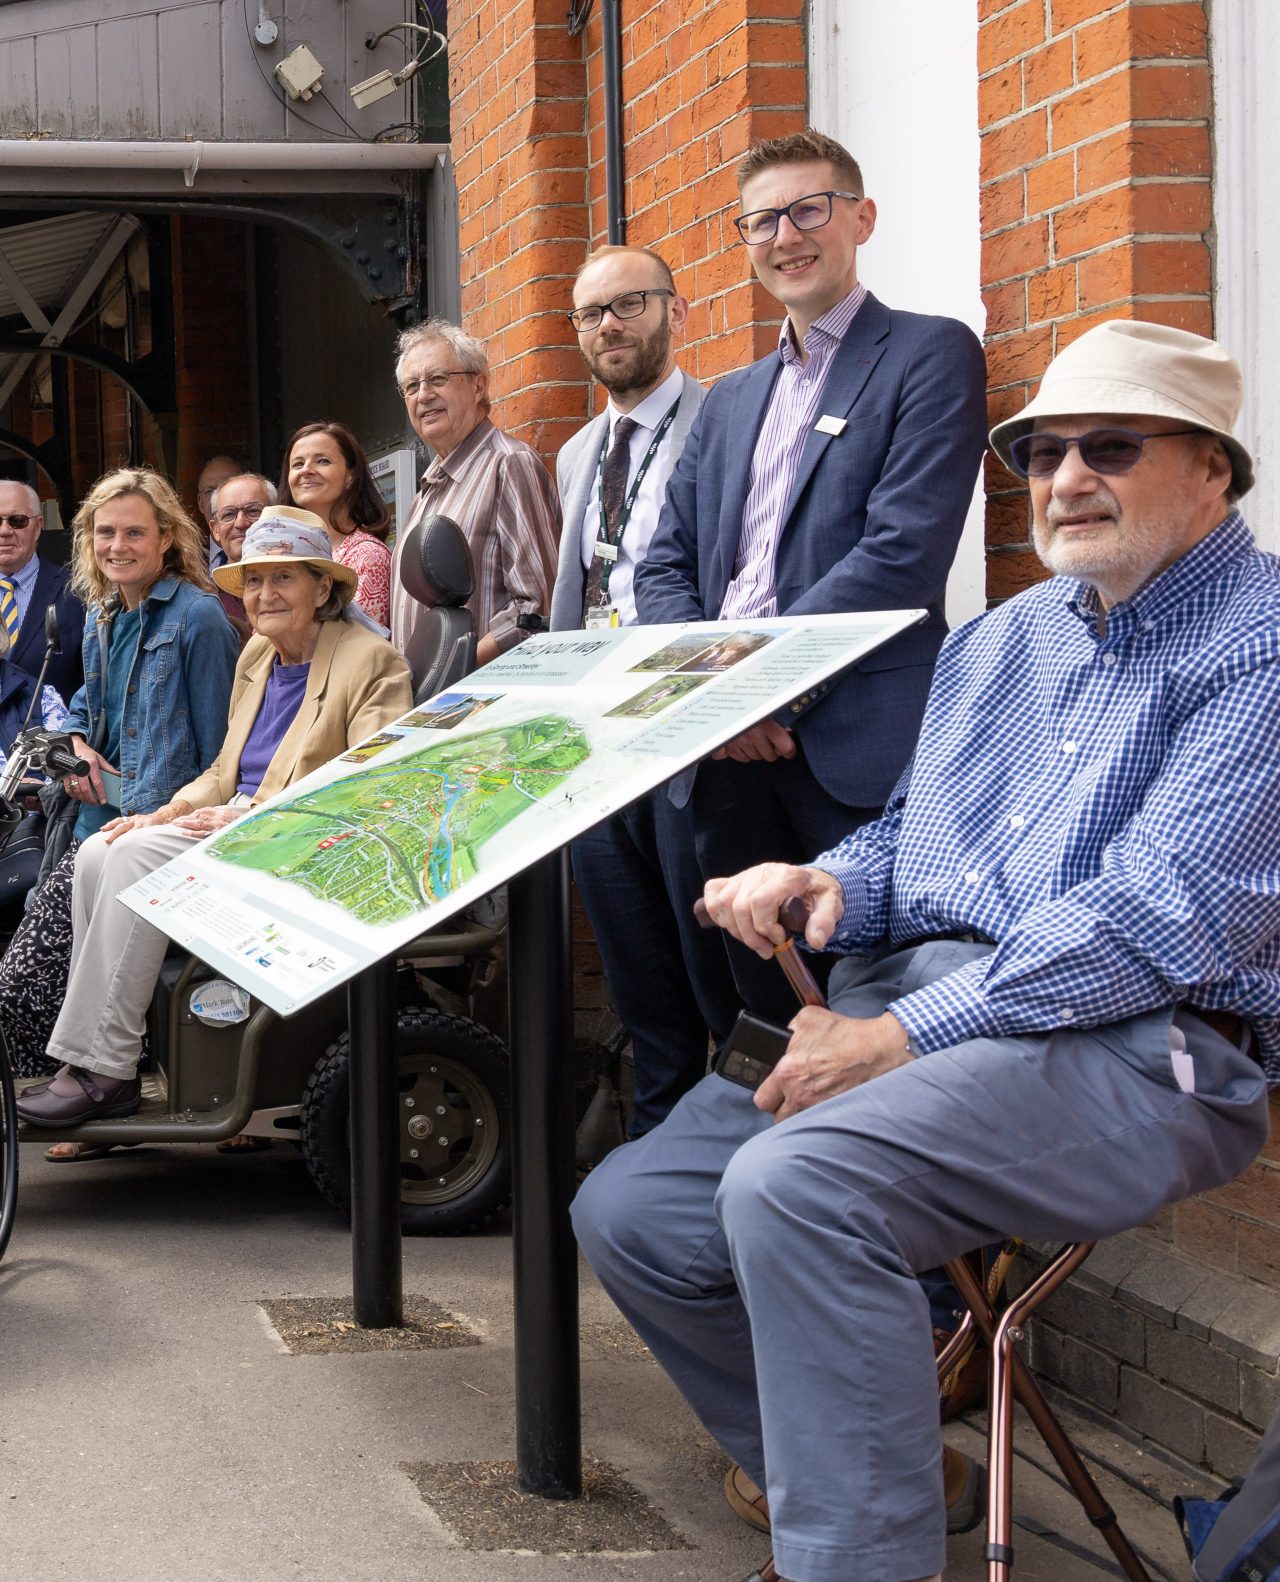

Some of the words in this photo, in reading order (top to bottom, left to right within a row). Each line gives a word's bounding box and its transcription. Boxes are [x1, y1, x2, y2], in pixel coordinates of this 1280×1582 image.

[507, 641, 552, 656] Find
[530, 642, 579, 659] your
[570, 640, 613, 657] way
[202, 1000, 218, 1009] Mark
